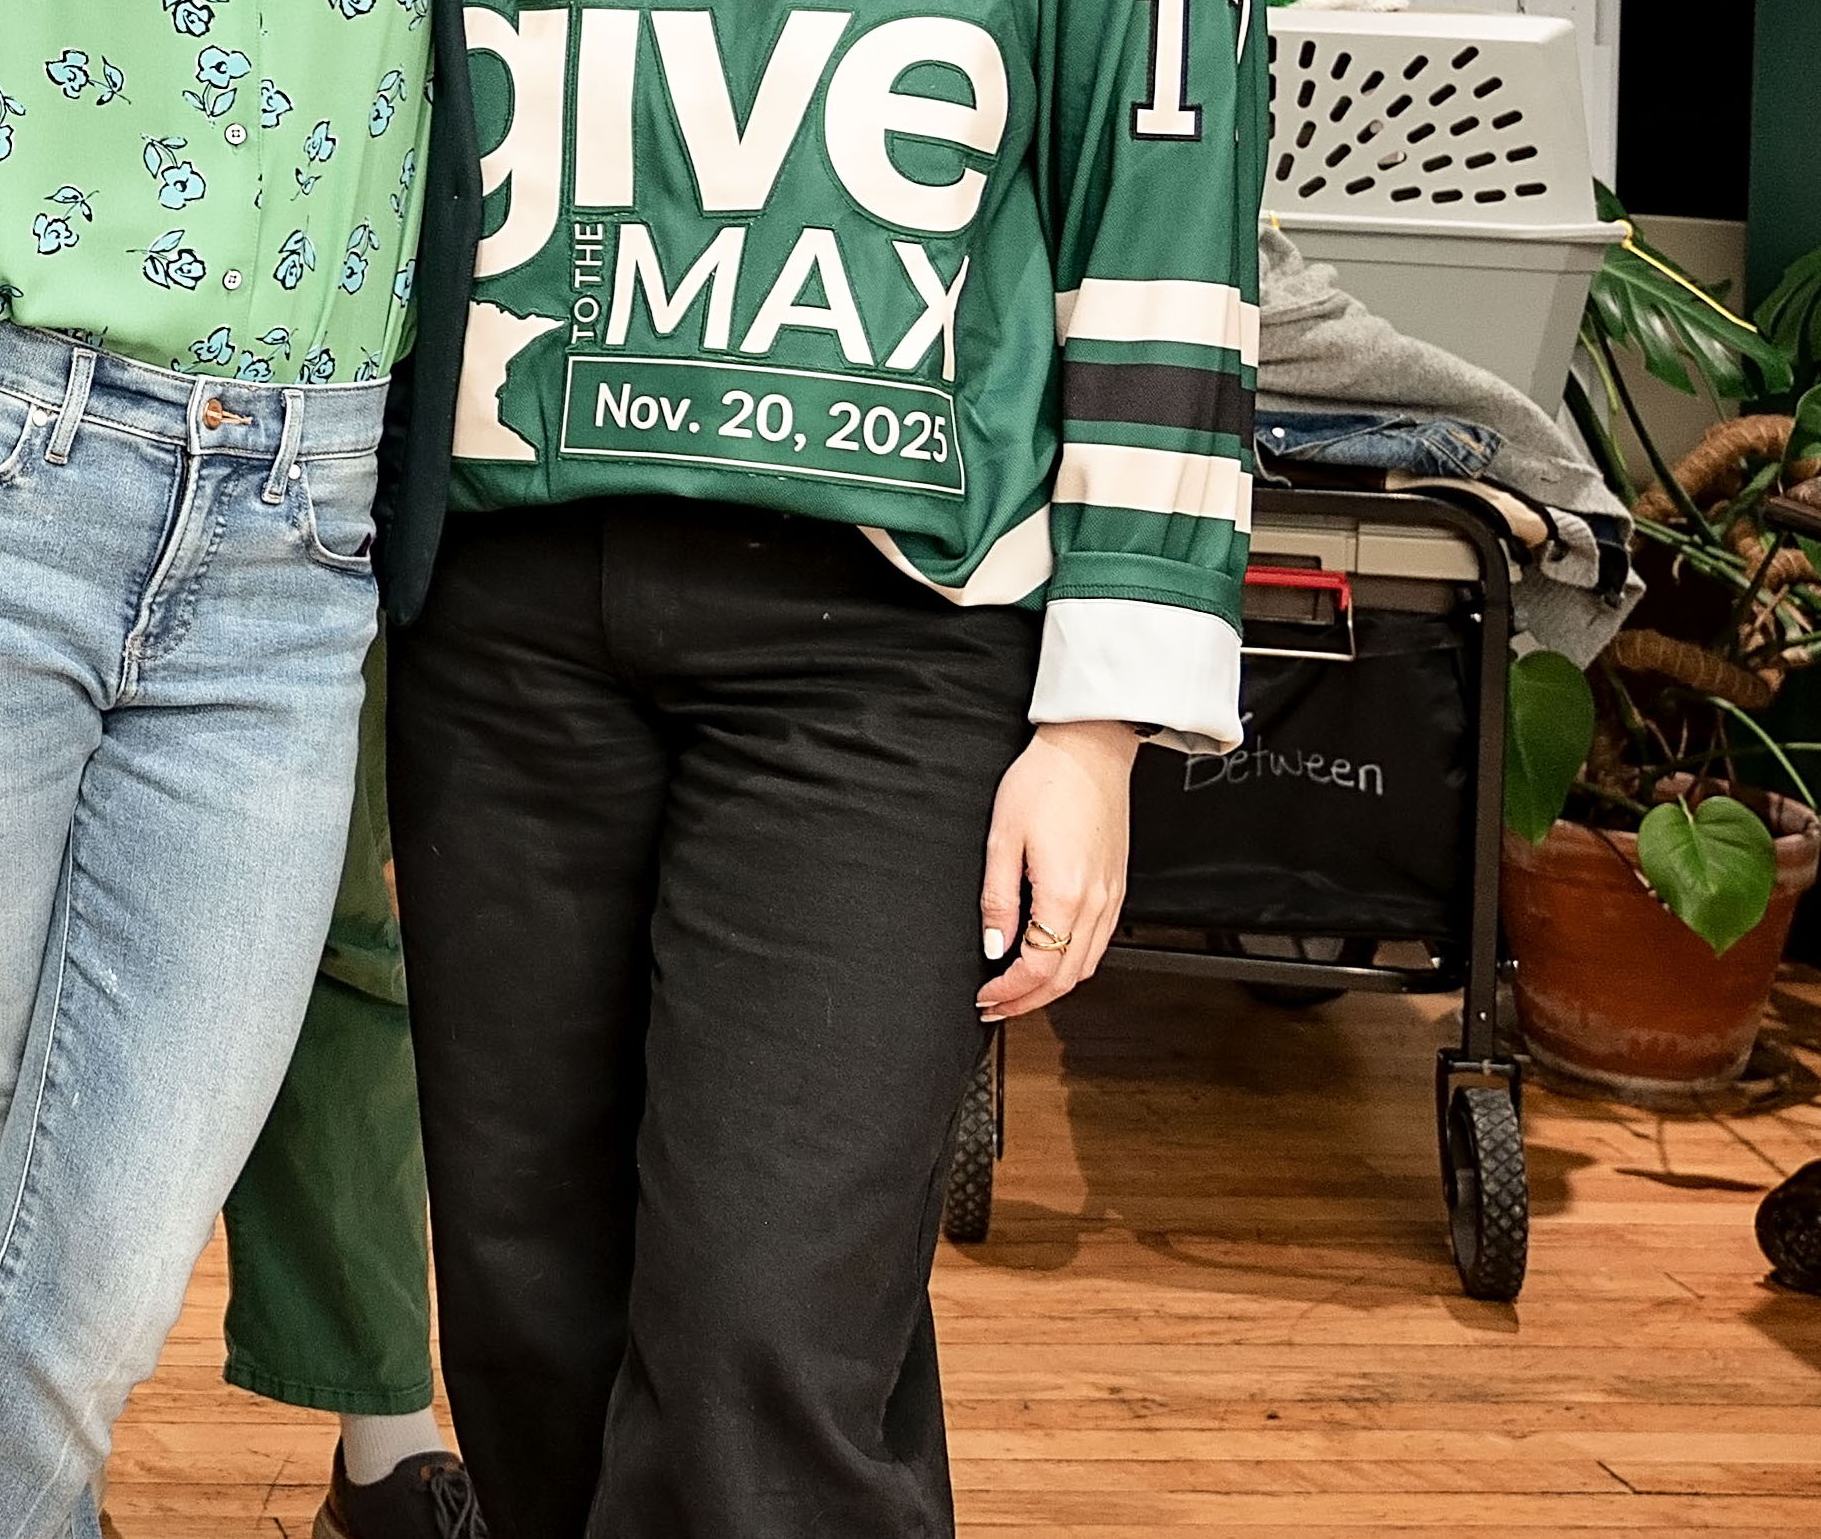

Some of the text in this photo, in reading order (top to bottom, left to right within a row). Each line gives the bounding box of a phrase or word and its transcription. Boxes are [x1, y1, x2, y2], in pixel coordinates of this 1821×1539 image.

[571, 222, 603, 344] TO THE
[605, 222, 970, 383] MAX
[594, 382, 949, 463] Nov. 20, 2025
